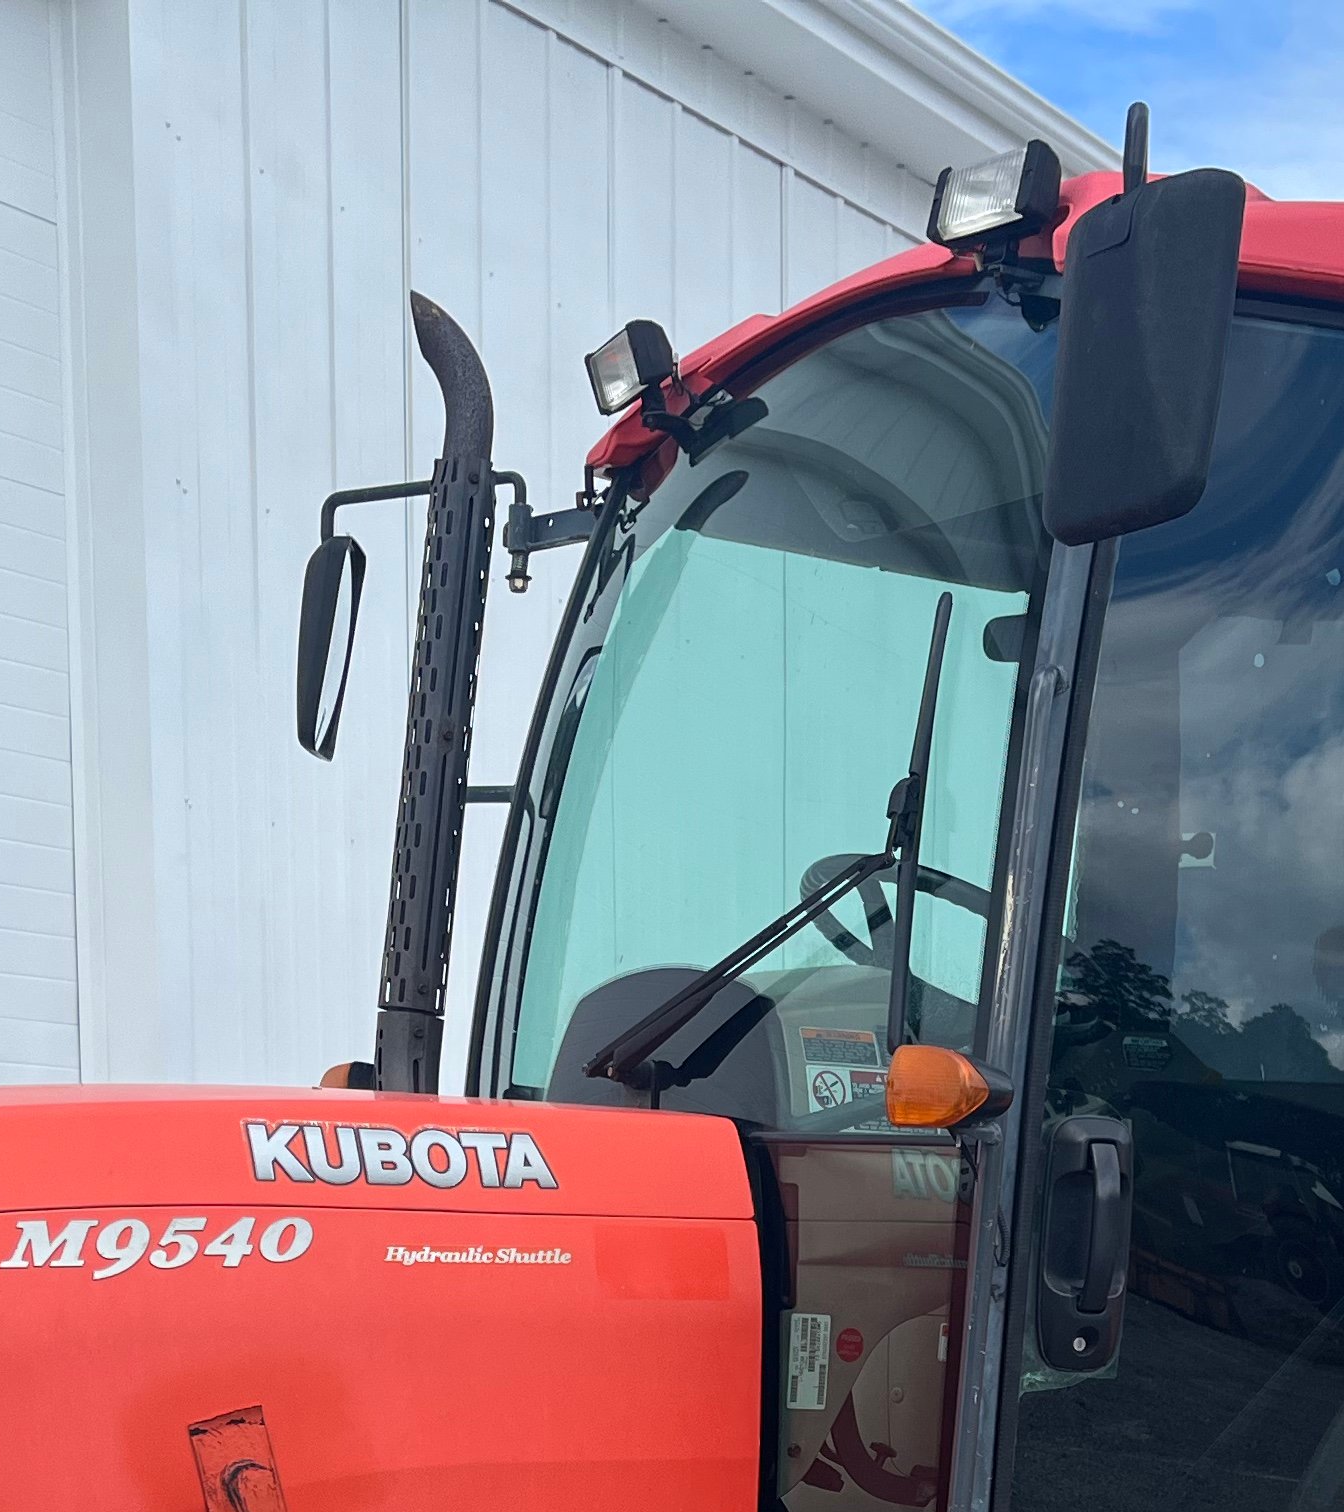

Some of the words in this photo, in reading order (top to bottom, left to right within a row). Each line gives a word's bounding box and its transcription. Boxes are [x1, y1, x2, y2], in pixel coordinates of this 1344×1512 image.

[245, 1121, 559, 1190] KUBOTA
[384, 1245, 494, 1266] Hydraulic
[494, 1247, 572, 1266] Shuttle
